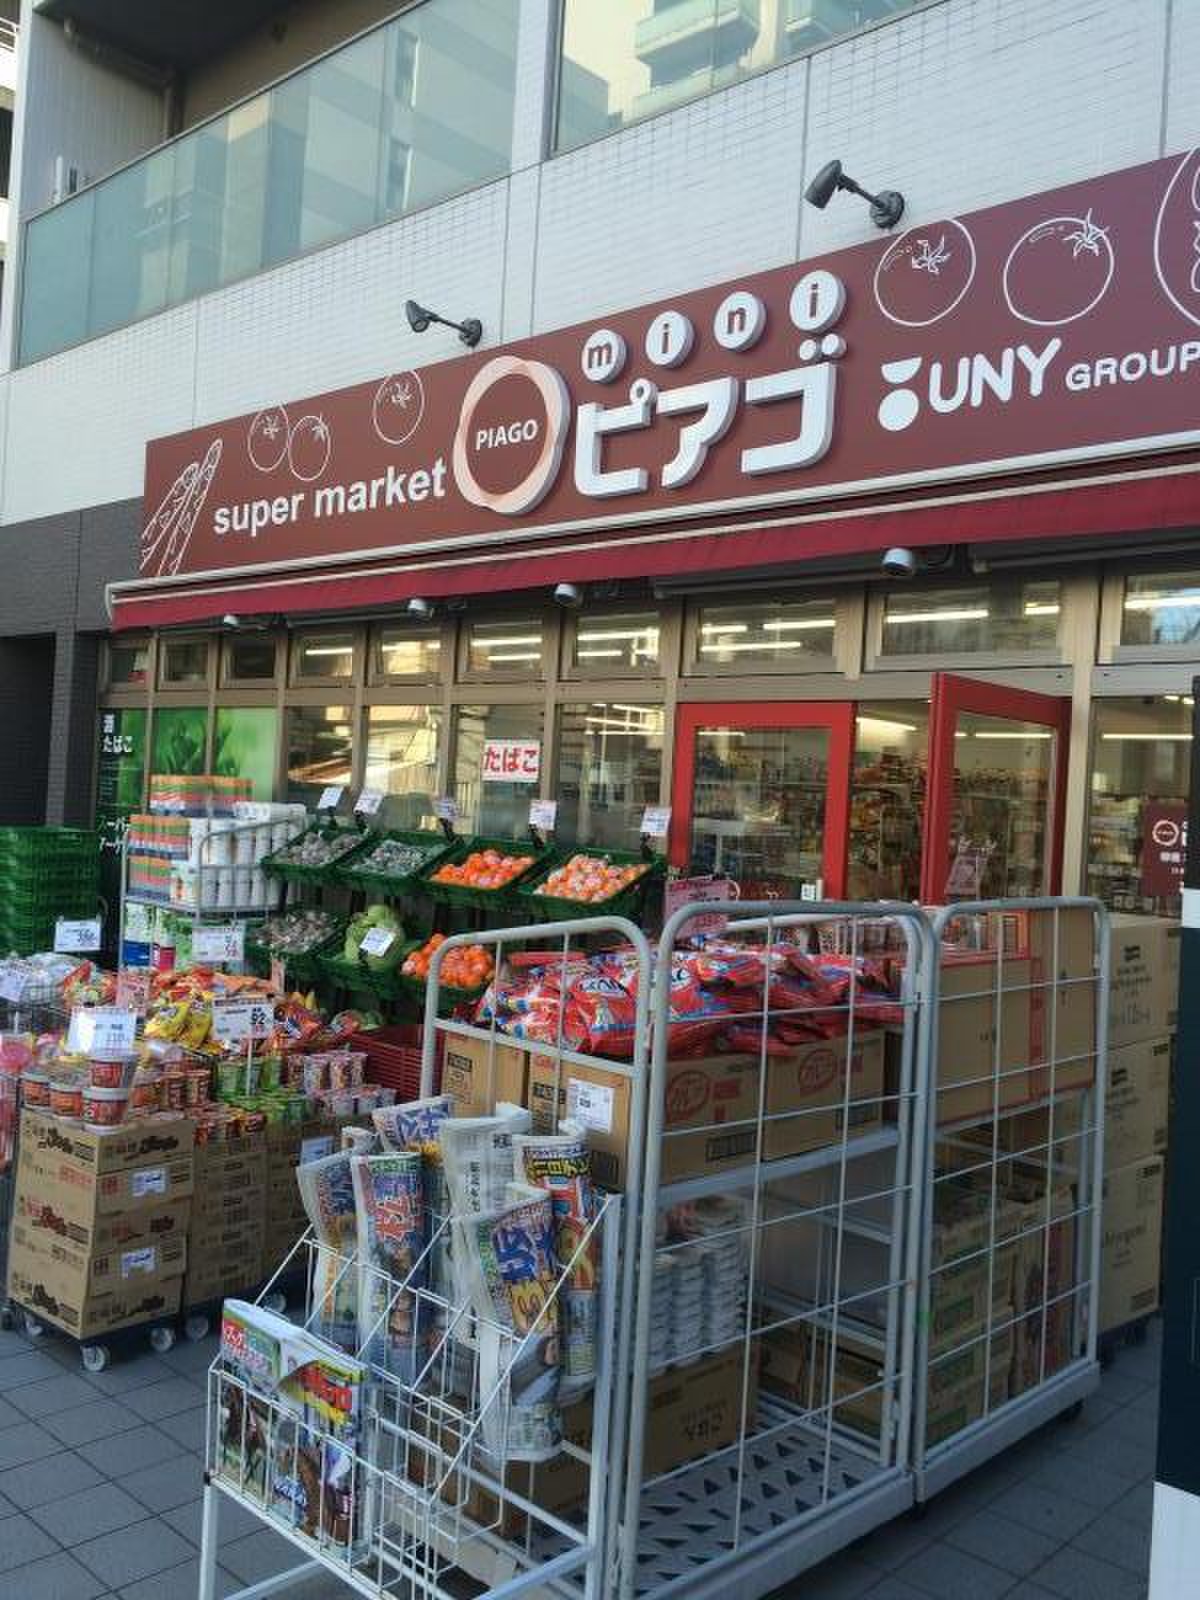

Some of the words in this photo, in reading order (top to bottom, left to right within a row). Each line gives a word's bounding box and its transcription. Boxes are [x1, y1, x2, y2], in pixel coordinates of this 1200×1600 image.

[583, 276, 833, 376] mini
[929, 337, 1064, 414] UNY
[1065, 340, 1200, 392] GROUP
[475, 418, 539, 452] PIAGO
[573, 332, 849, 499] ピアゴ
[213, 489, 305, 538] super
[313, 458, 448, 519] market
[482, 746, 537, 772] たばこ
